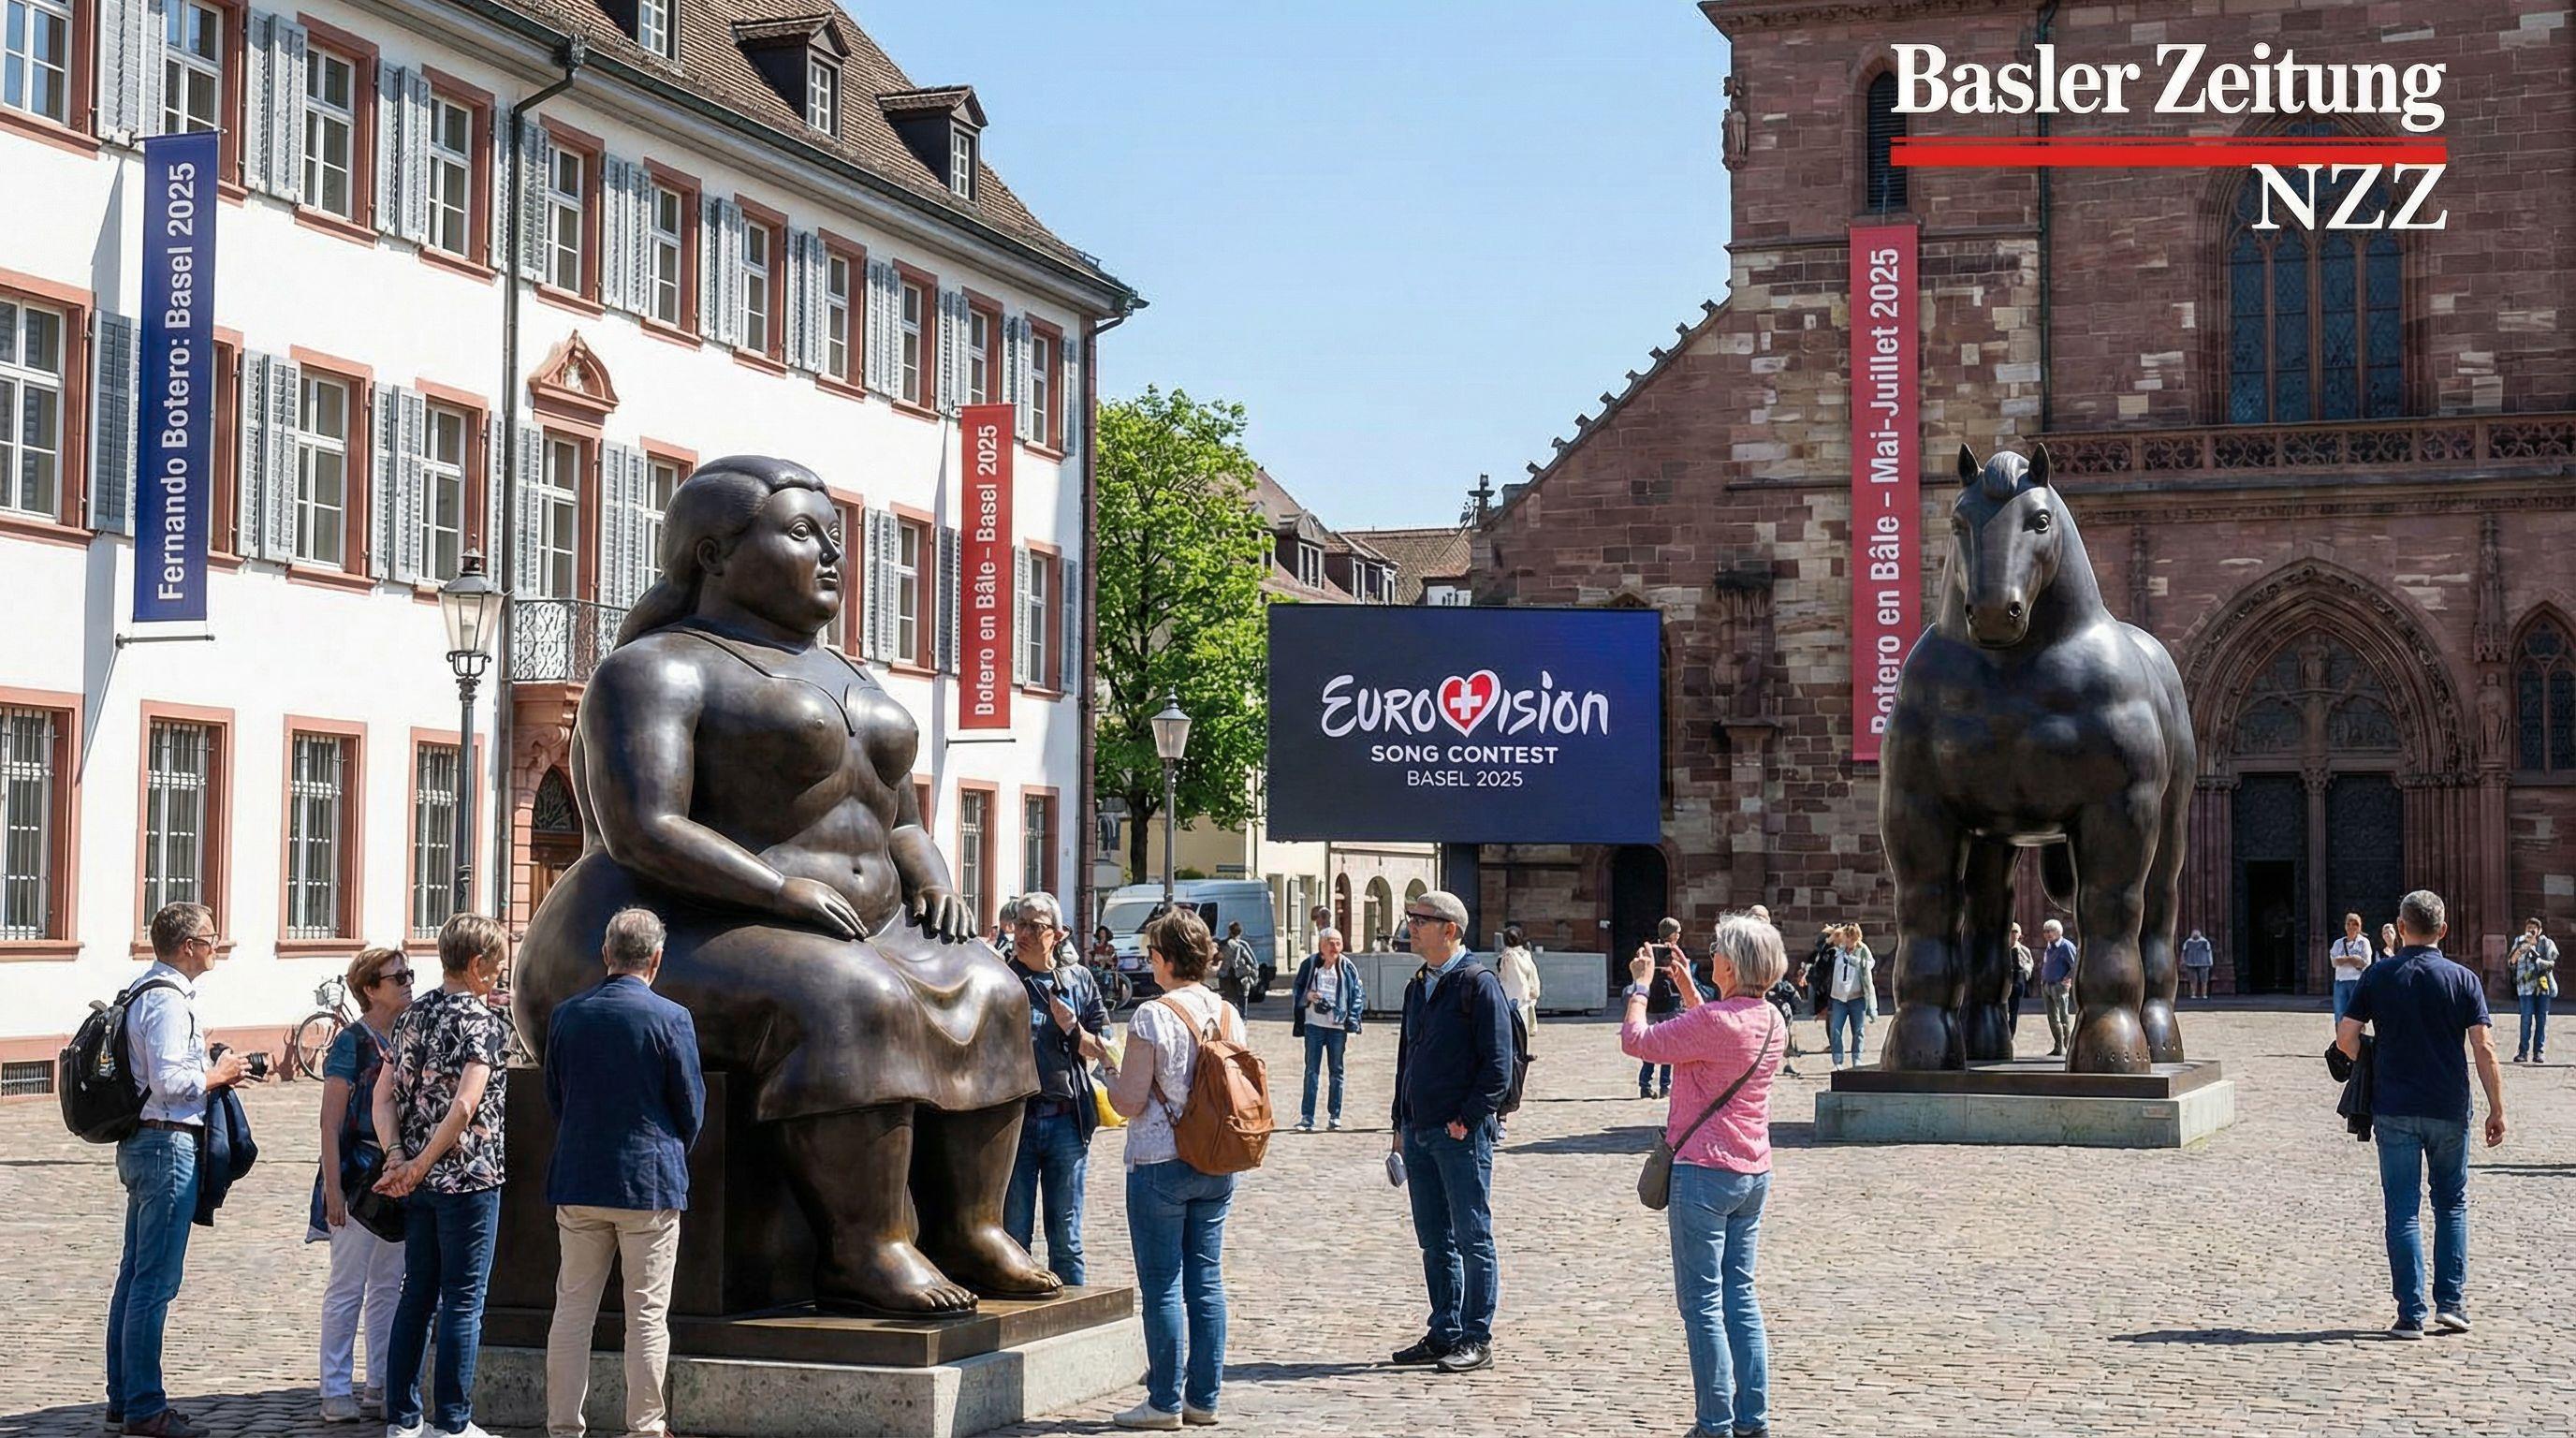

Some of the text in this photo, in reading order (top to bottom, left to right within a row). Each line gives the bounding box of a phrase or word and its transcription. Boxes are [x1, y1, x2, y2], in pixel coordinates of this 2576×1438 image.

[1869, 248, 1899, 318] 2025
[157, 162, 196, 601] Fernando Botero: Basel 2025
[1869, 326, 1900, 483] Mai-Juillet
[976, 424, 998, 476] 2025
[1867, 516, 1900, 580] Bâle
[980, 615, 997, 640] en
[1877, 590, 1901, 625] en
[1370, 744, 1559, 764] SONG CONTEST
[1407, 770, 1523, 787] BASEL 2025
